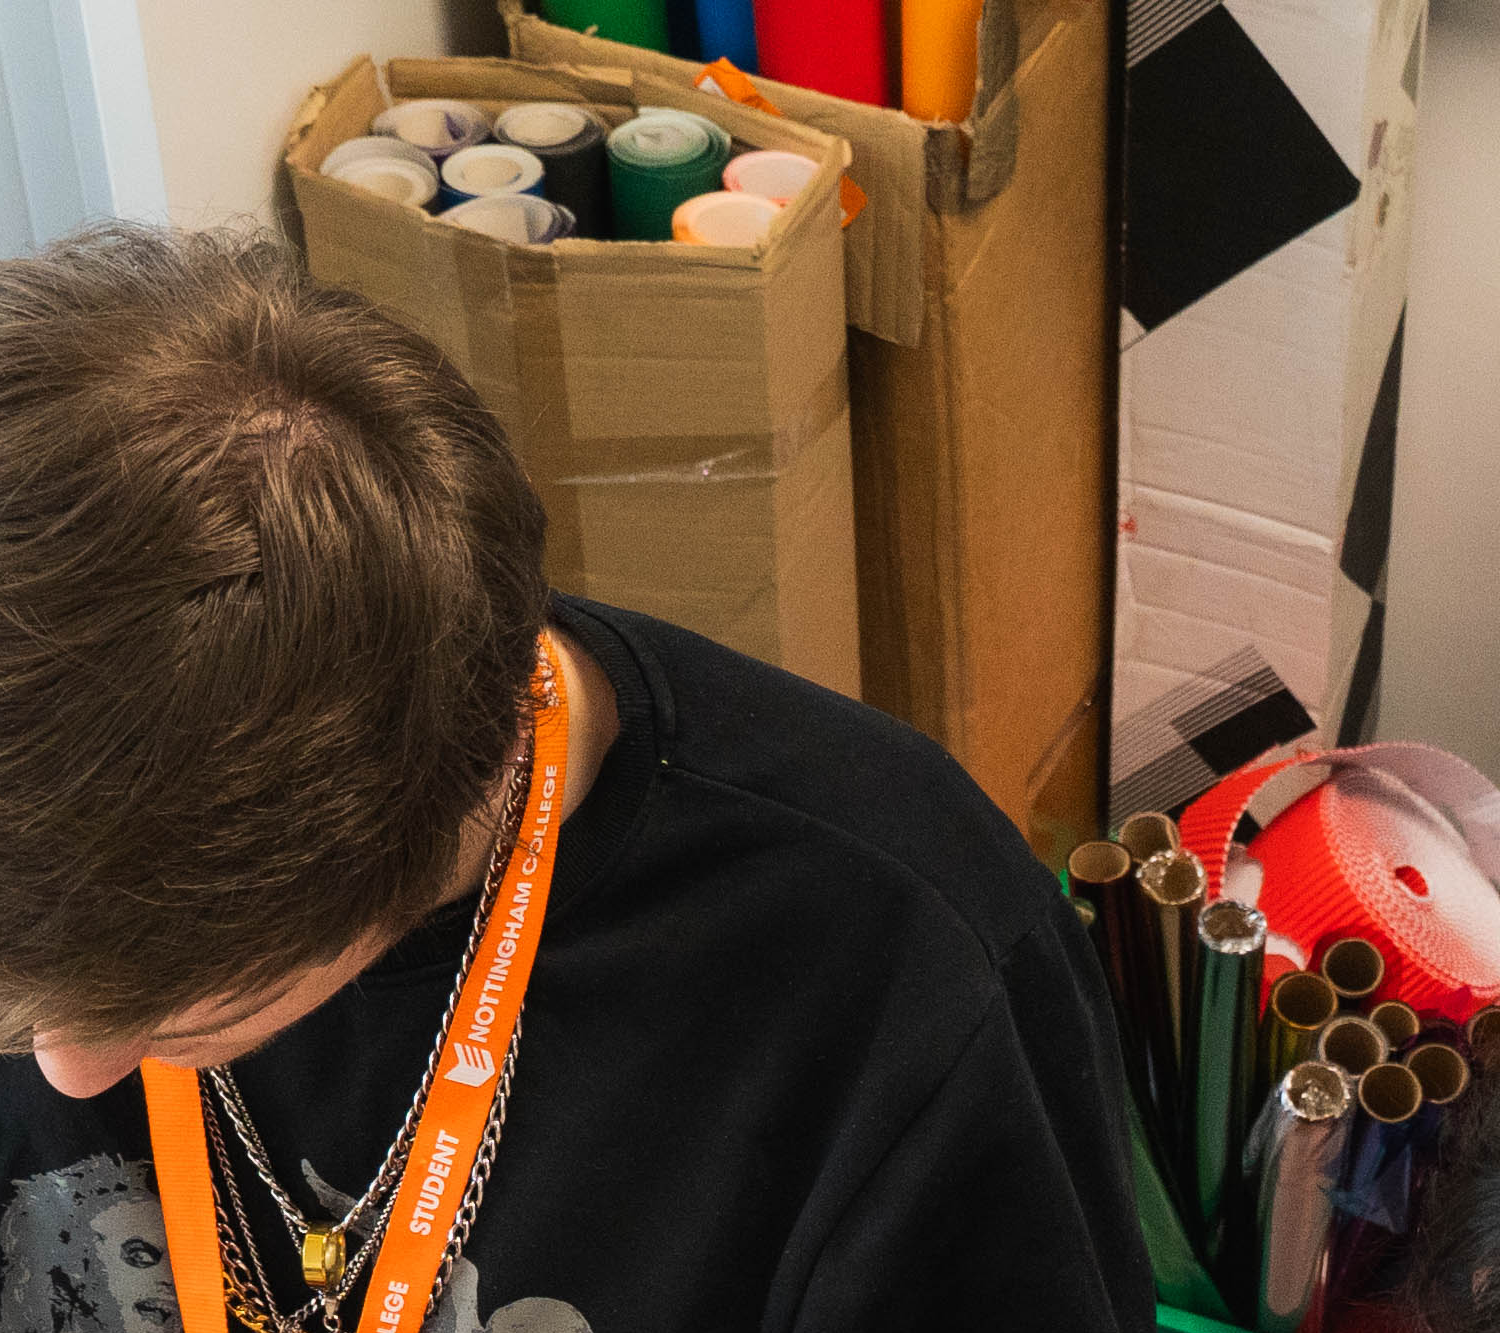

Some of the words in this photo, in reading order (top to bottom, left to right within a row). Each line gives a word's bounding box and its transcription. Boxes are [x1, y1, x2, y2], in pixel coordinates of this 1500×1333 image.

[468, 882, 532, 1043] NOTTINGHAM
[522, 765, 557, 876] COLLEGE
[410, 1130, 460, 1236] STUDENT
